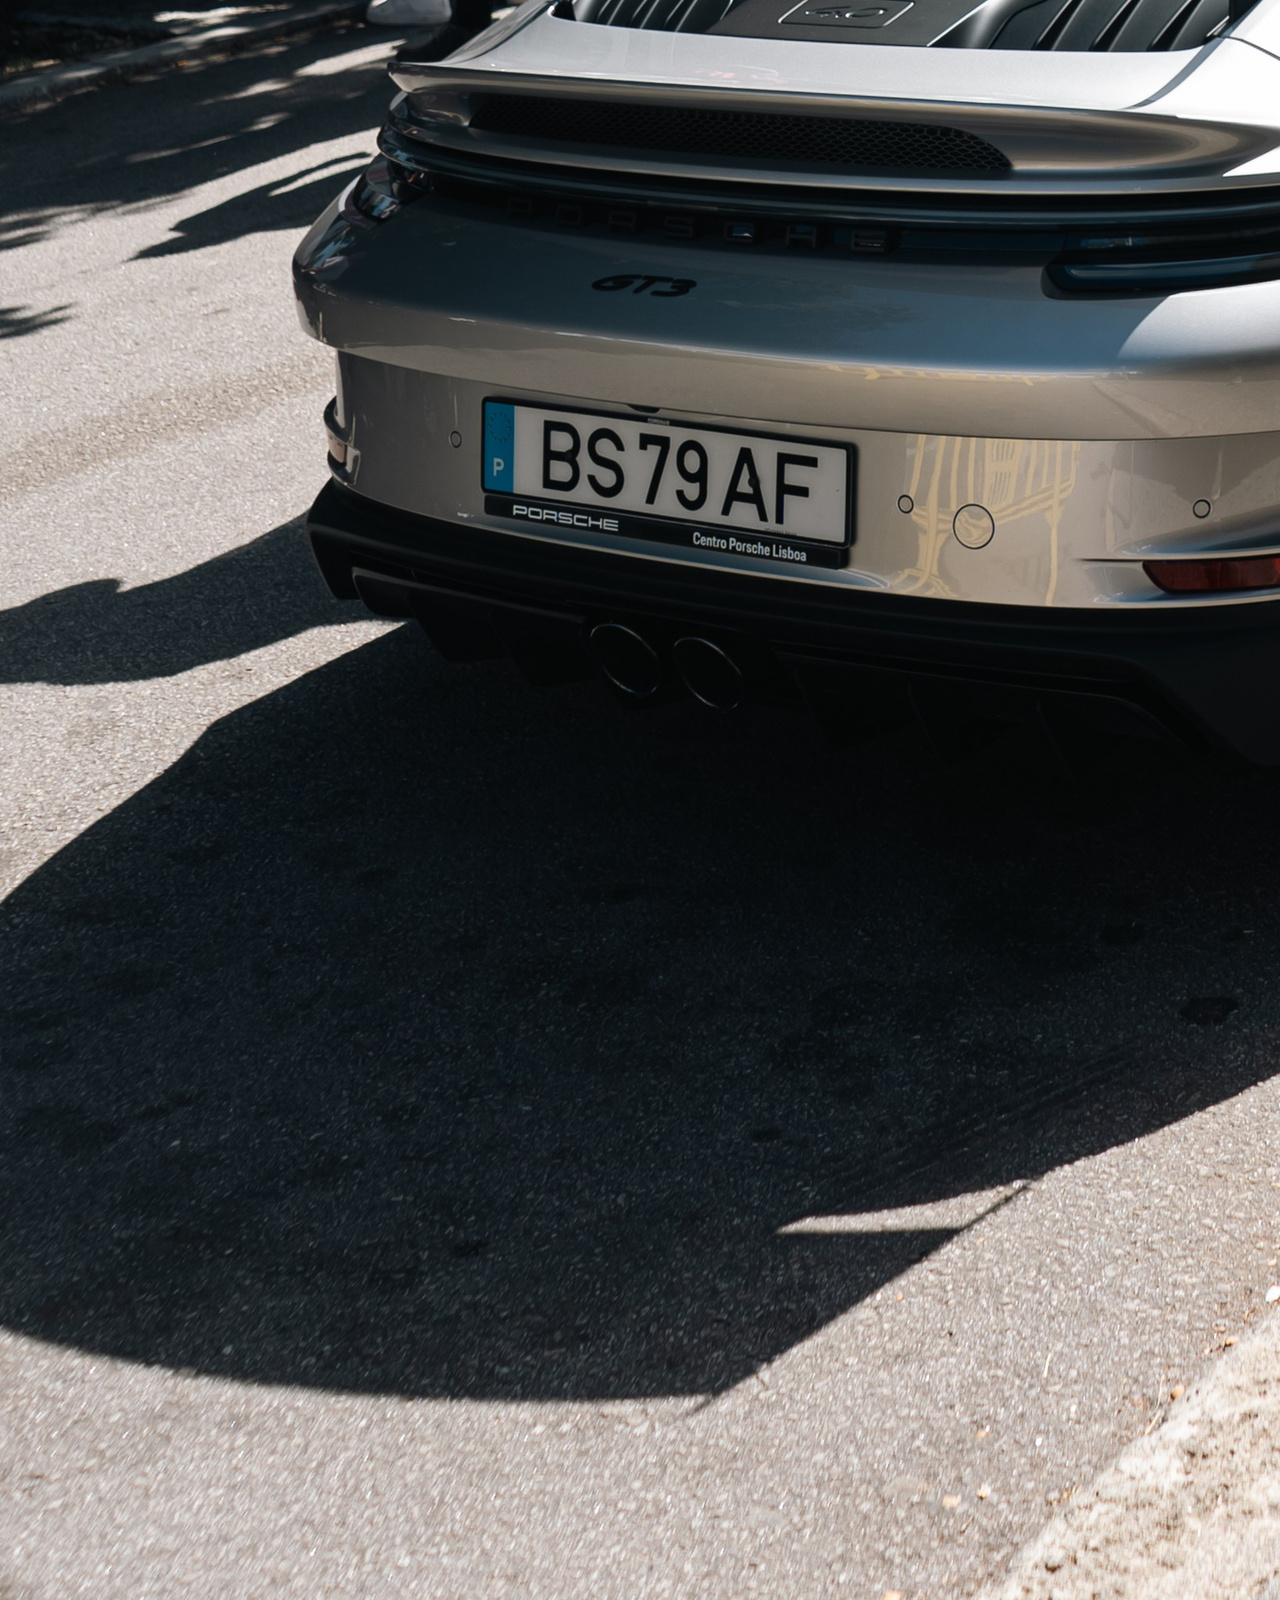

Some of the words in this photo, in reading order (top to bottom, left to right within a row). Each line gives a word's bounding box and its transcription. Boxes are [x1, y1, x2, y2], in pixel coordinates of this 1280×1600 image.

[506, 197, 890, 254] PORSCHE
[591, 274, 697, 297] GT3
[493, 457, 505, 477] P
[512, 505, 619, 532] PORSCHE
[692, 531, 727, 549] Centro
[729, 537, 771, 556] Porsche
[772, 544, 808, 562] Lisboa
